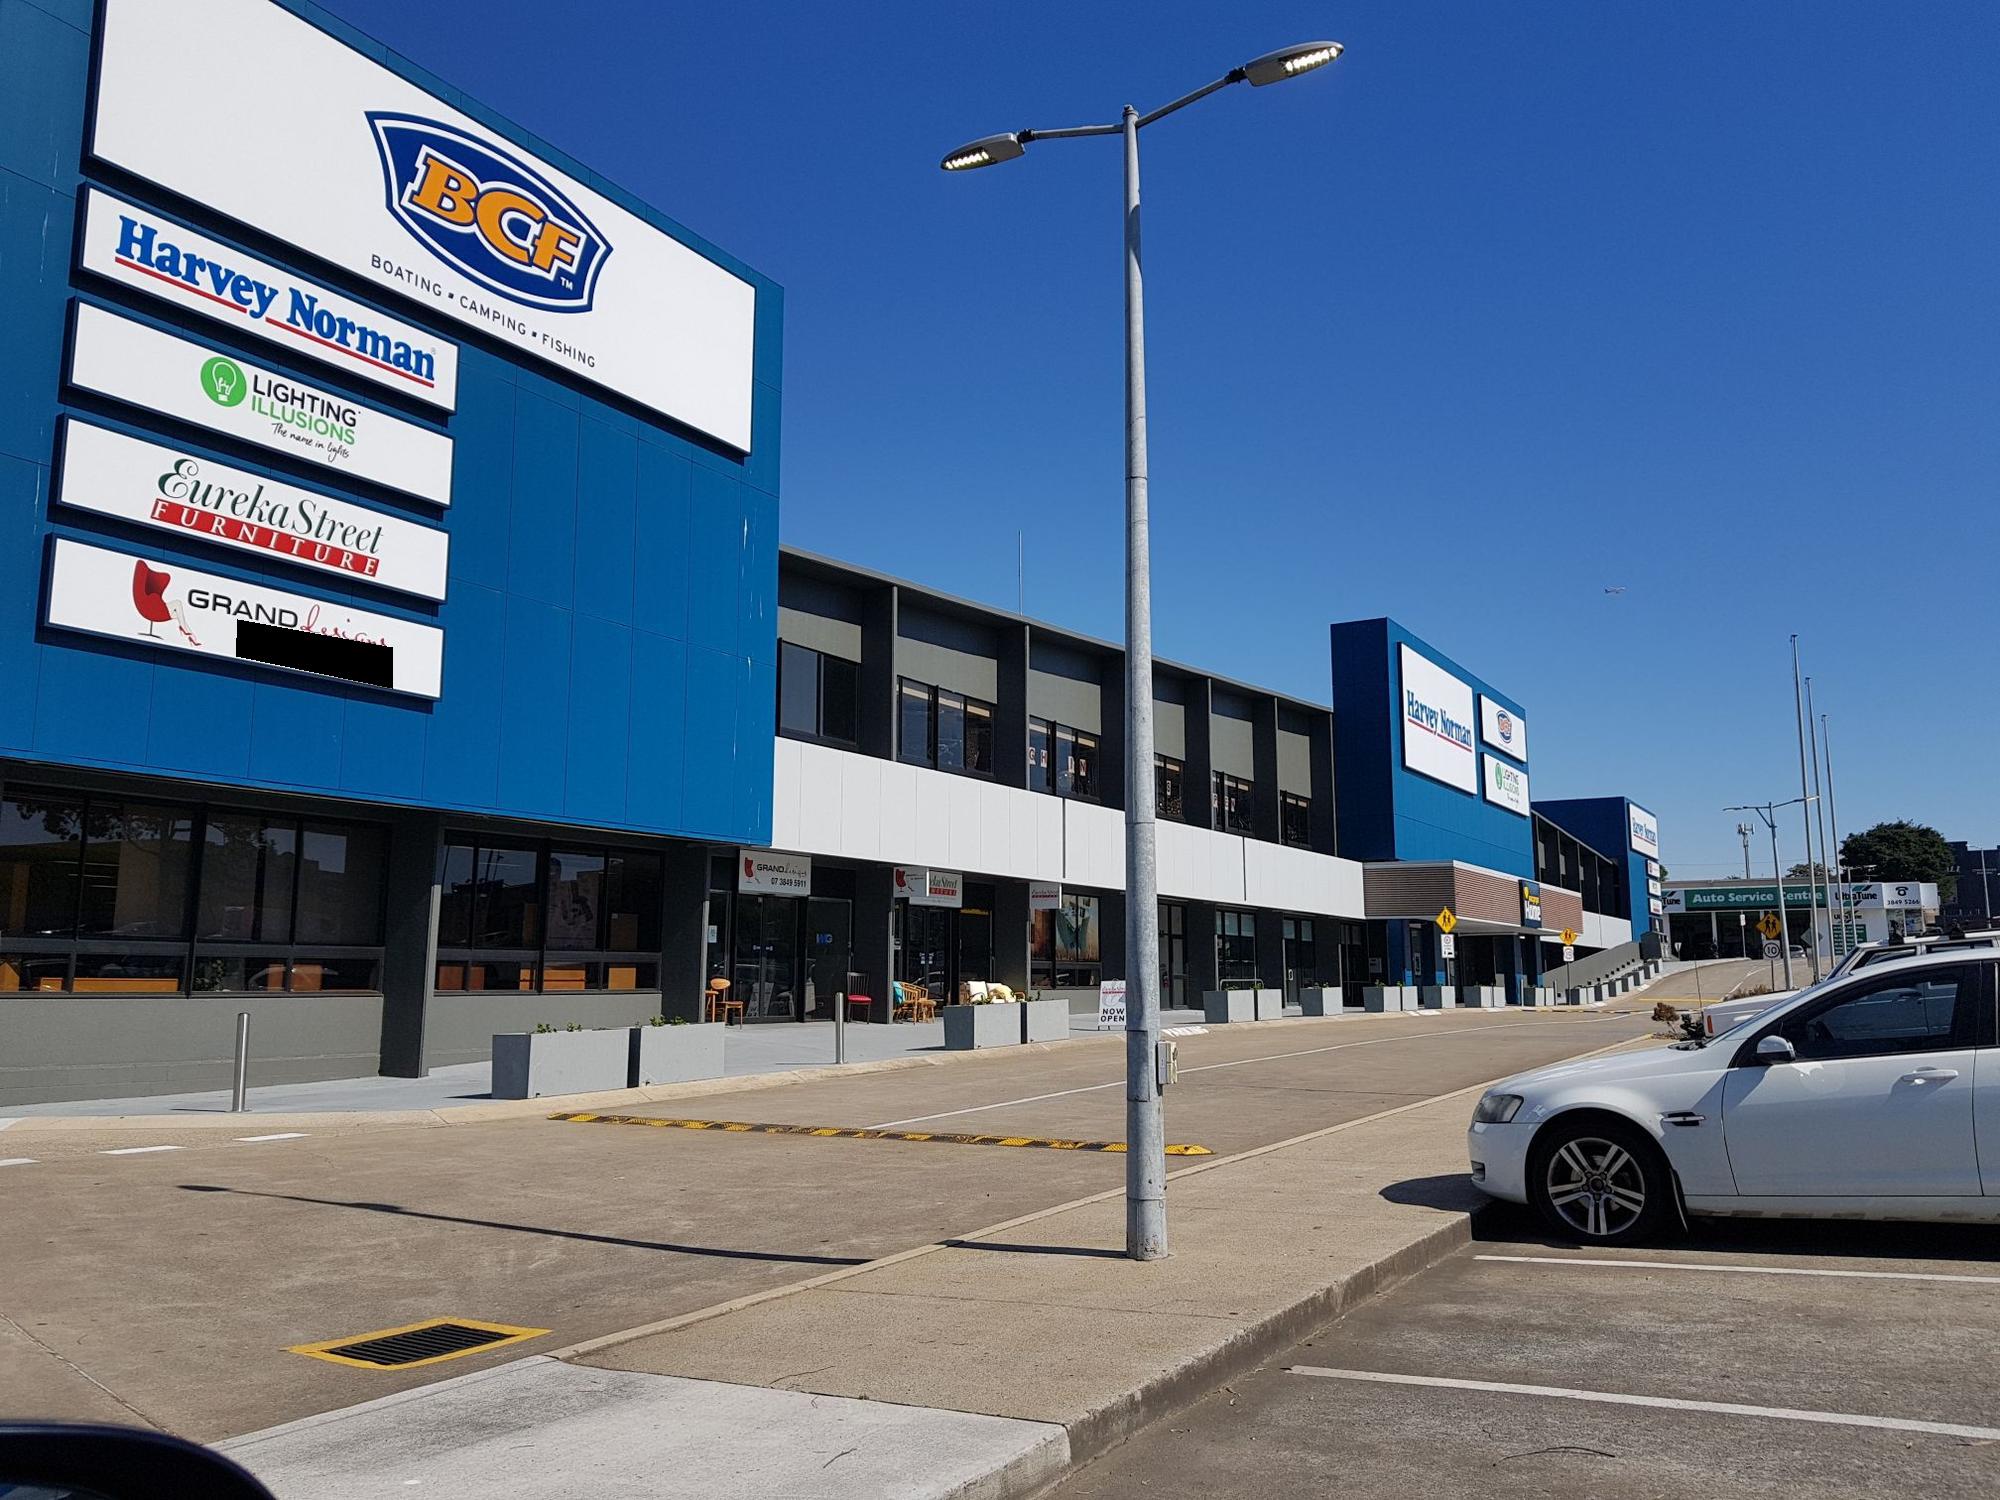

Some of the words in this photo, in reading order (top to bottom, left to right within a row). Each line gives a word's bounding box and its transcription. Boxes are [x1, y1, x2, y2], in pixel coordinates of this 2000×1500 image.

[406, 150, 583, 275] BCF
[115, 214, 279, 319] Harvey
[287, 286, 436, 381] Norman
[370, 253, 443, 298] BOATING
[459, 295, 527, 336] CAMPING
[541, 333, 597, 369] FISHING
[251, 395, 356, 446] ILLUSIONS
[252, 374, 358, 428] LIGHTING
[271, 422, 288, 437] The
[289, 431, 313, 447] name
[315, 440, 325, 450] in
[326, 442, 350, 463] lights
[152, 499, 378, 576] FURNITURE
[186, 588, 299, 629] GRAND
[1406, 689, 1439, 736] Harvey
[1440, 708, 1473, 748] Norman
[756, 863, 785, 873] GRAND
[1692, 893, 1725, 903] Auto
[1728, 891, 1774, 902] Service
[1768, 945, 1777, 954] 10
[1100, 1015, 1125, 1023] OPEN
[1102, 1007, 1125, 1015] NOW
